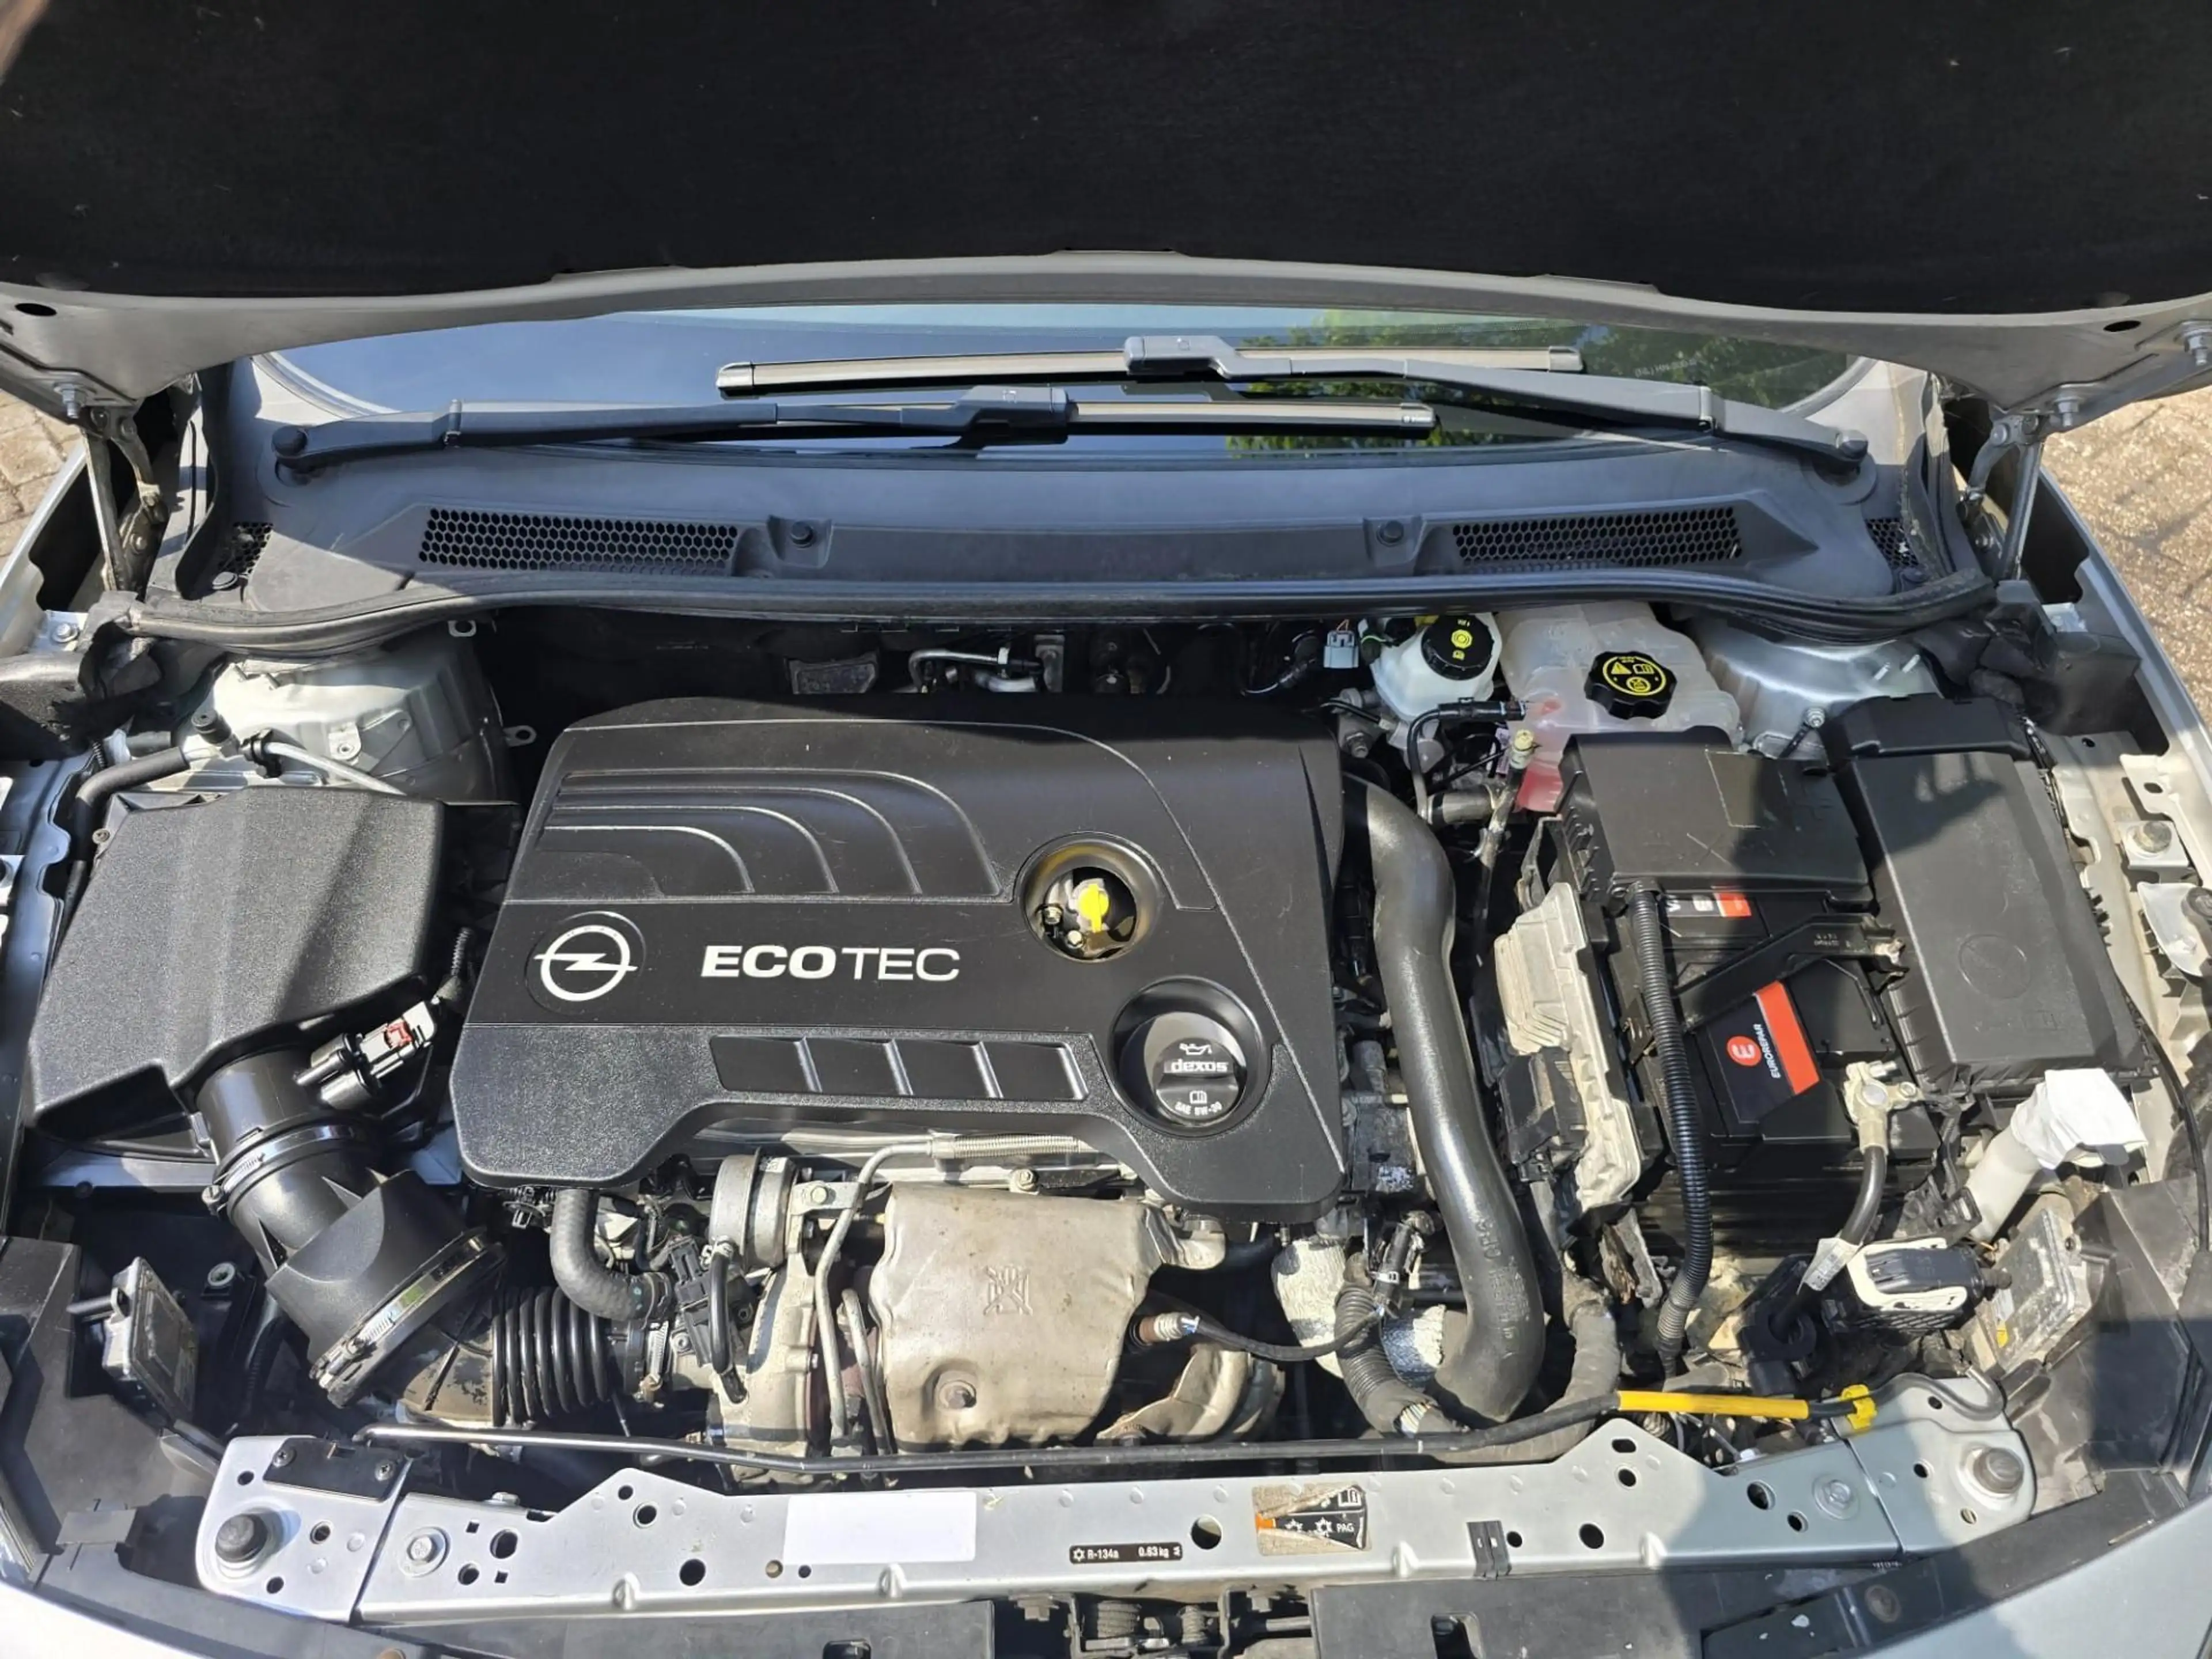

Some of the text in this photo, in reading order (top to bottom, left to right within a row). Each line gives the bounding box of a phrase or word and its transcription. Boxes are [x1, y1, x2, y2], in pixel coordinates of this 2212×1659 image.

[700, 945, 961, 982] ECOTEC
[1753, 1024, 1781, 1078] EUROREPAR
[1171, 1058, 1229, 1073] dexos
[1336, 1522, 1355, 1533] PAG
[1088, 1548, 1120, 1560] R-134a
